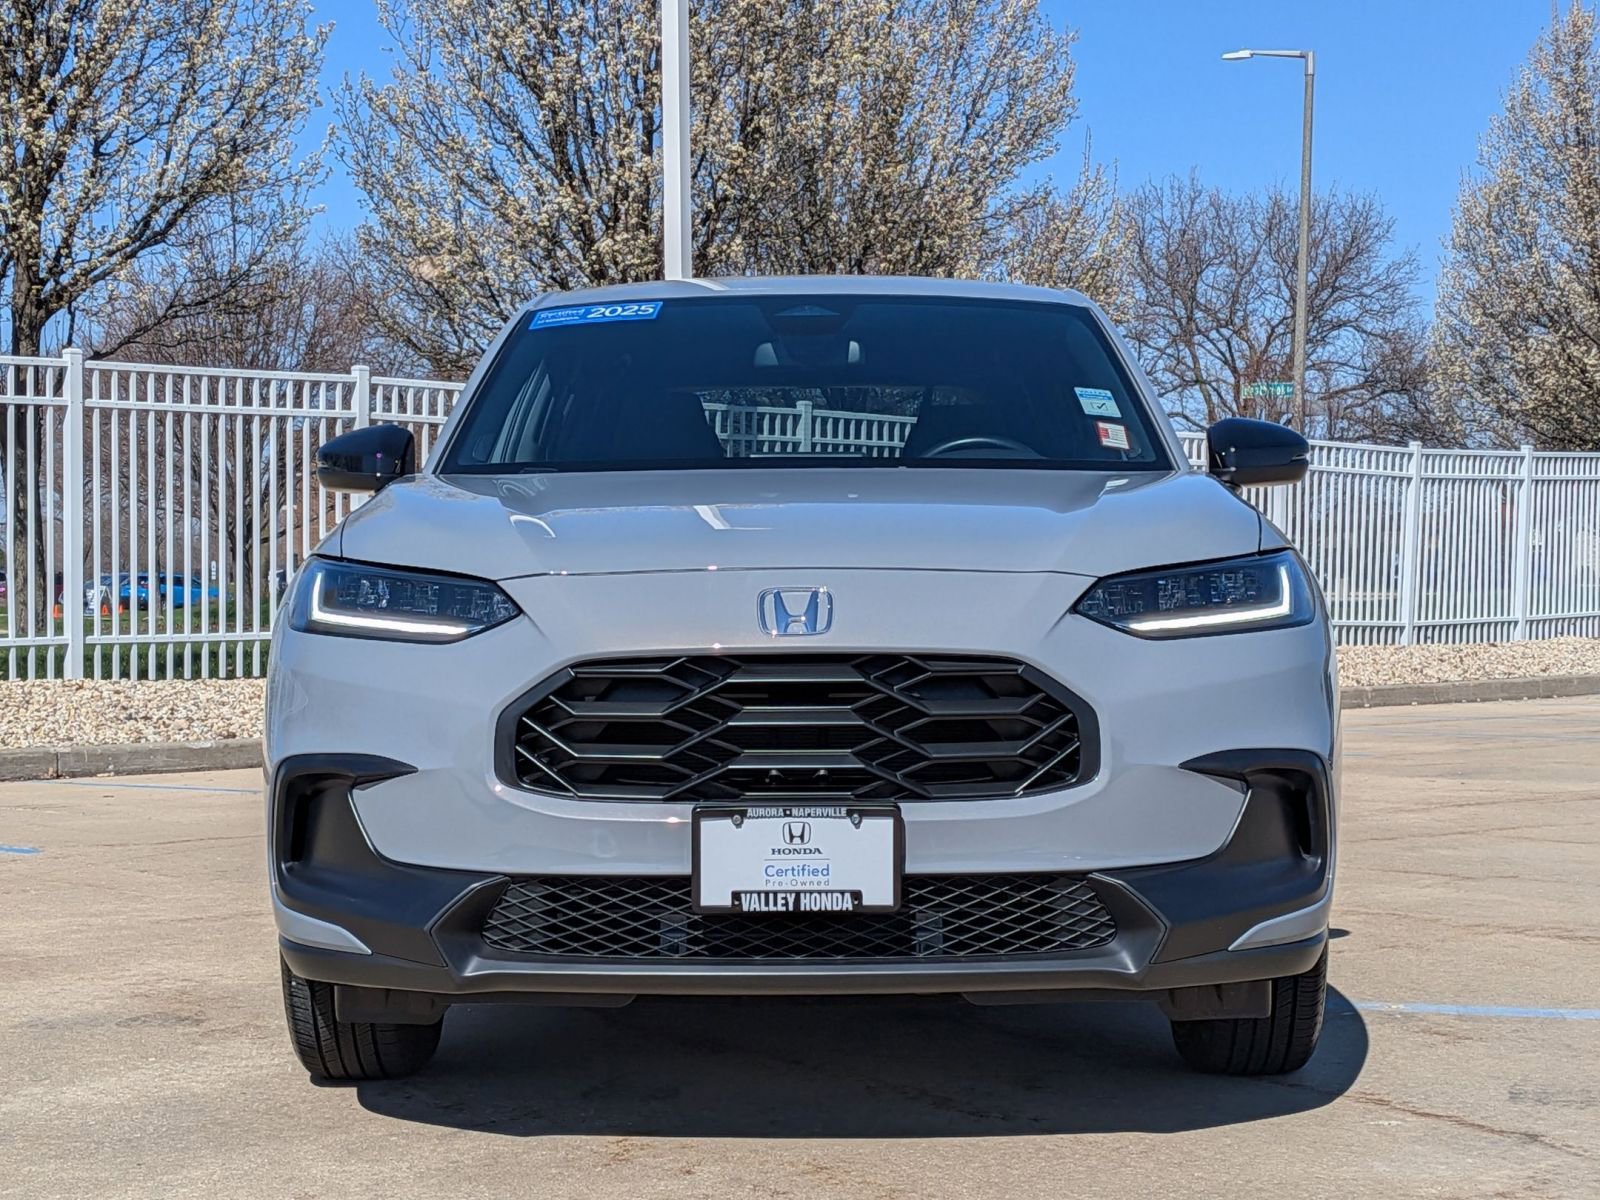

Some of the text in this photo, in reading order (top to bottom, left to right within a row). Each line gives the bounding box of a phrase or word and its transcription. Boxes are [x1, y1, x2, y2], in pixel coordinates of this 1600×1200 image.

[586, 305, 656, 318] 2025
[747, 807, 847, 817] AURORA NAPERVILLE
[770, 847, 823, 856] HONDA
[764, 864, 830, 877] Certified
[765, 878, 830, 887] Pre-Owned
[740, 892, 853, 912] VALLEY HONDA
